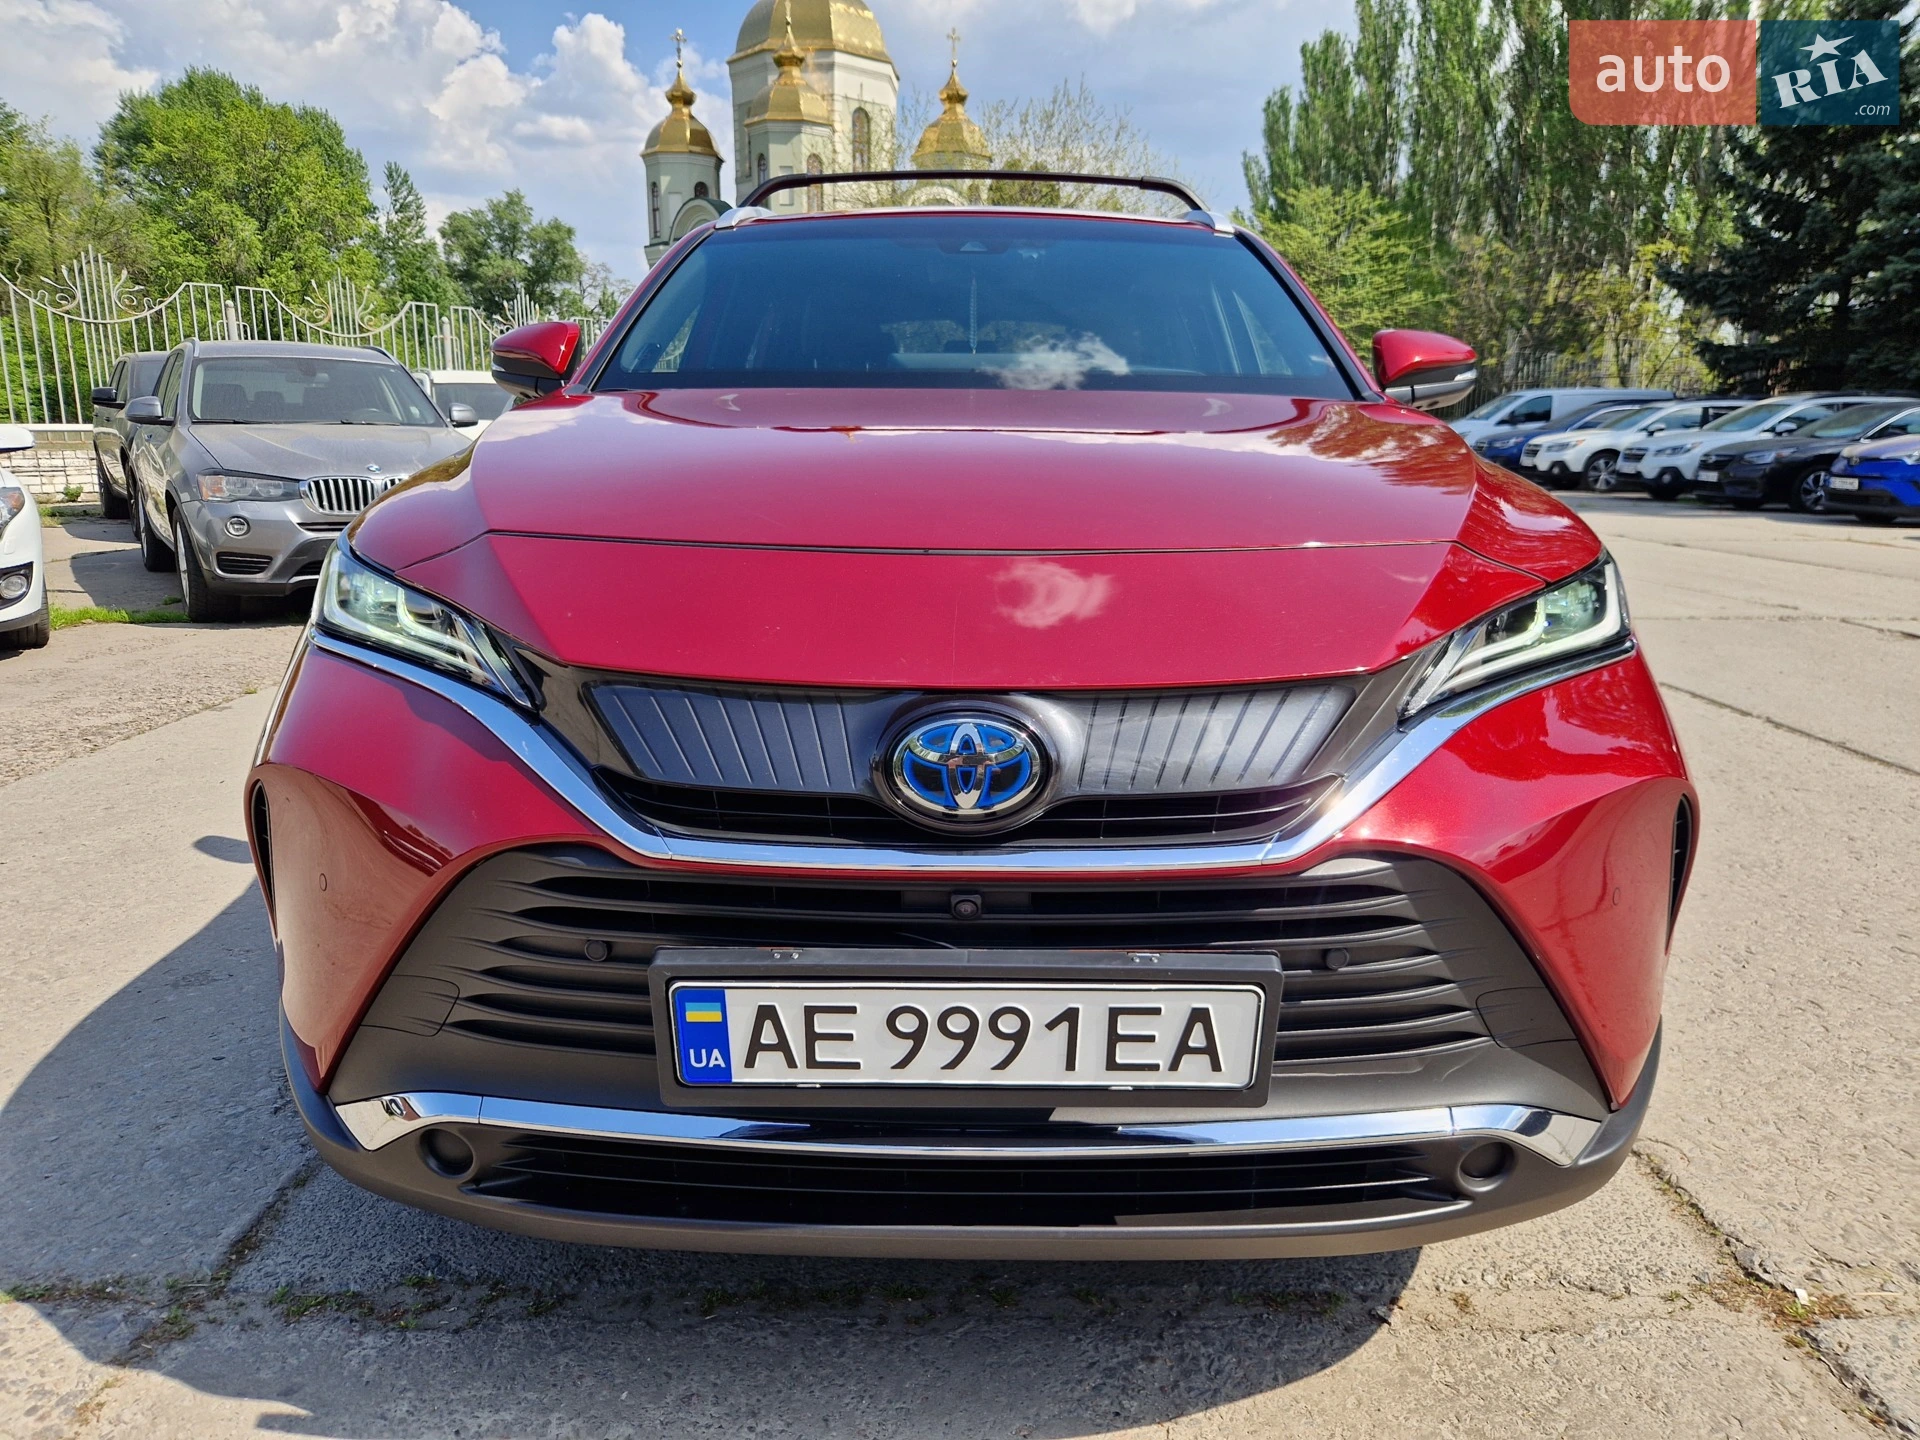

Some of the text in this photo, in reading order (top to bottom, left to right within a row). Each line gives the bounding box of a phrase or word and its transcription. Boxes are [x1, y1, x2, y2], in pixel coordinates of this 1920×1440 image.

[689, 1048, 726, 1068] UA
[744, 1004, 1223, 1073] AE 9991 EA
